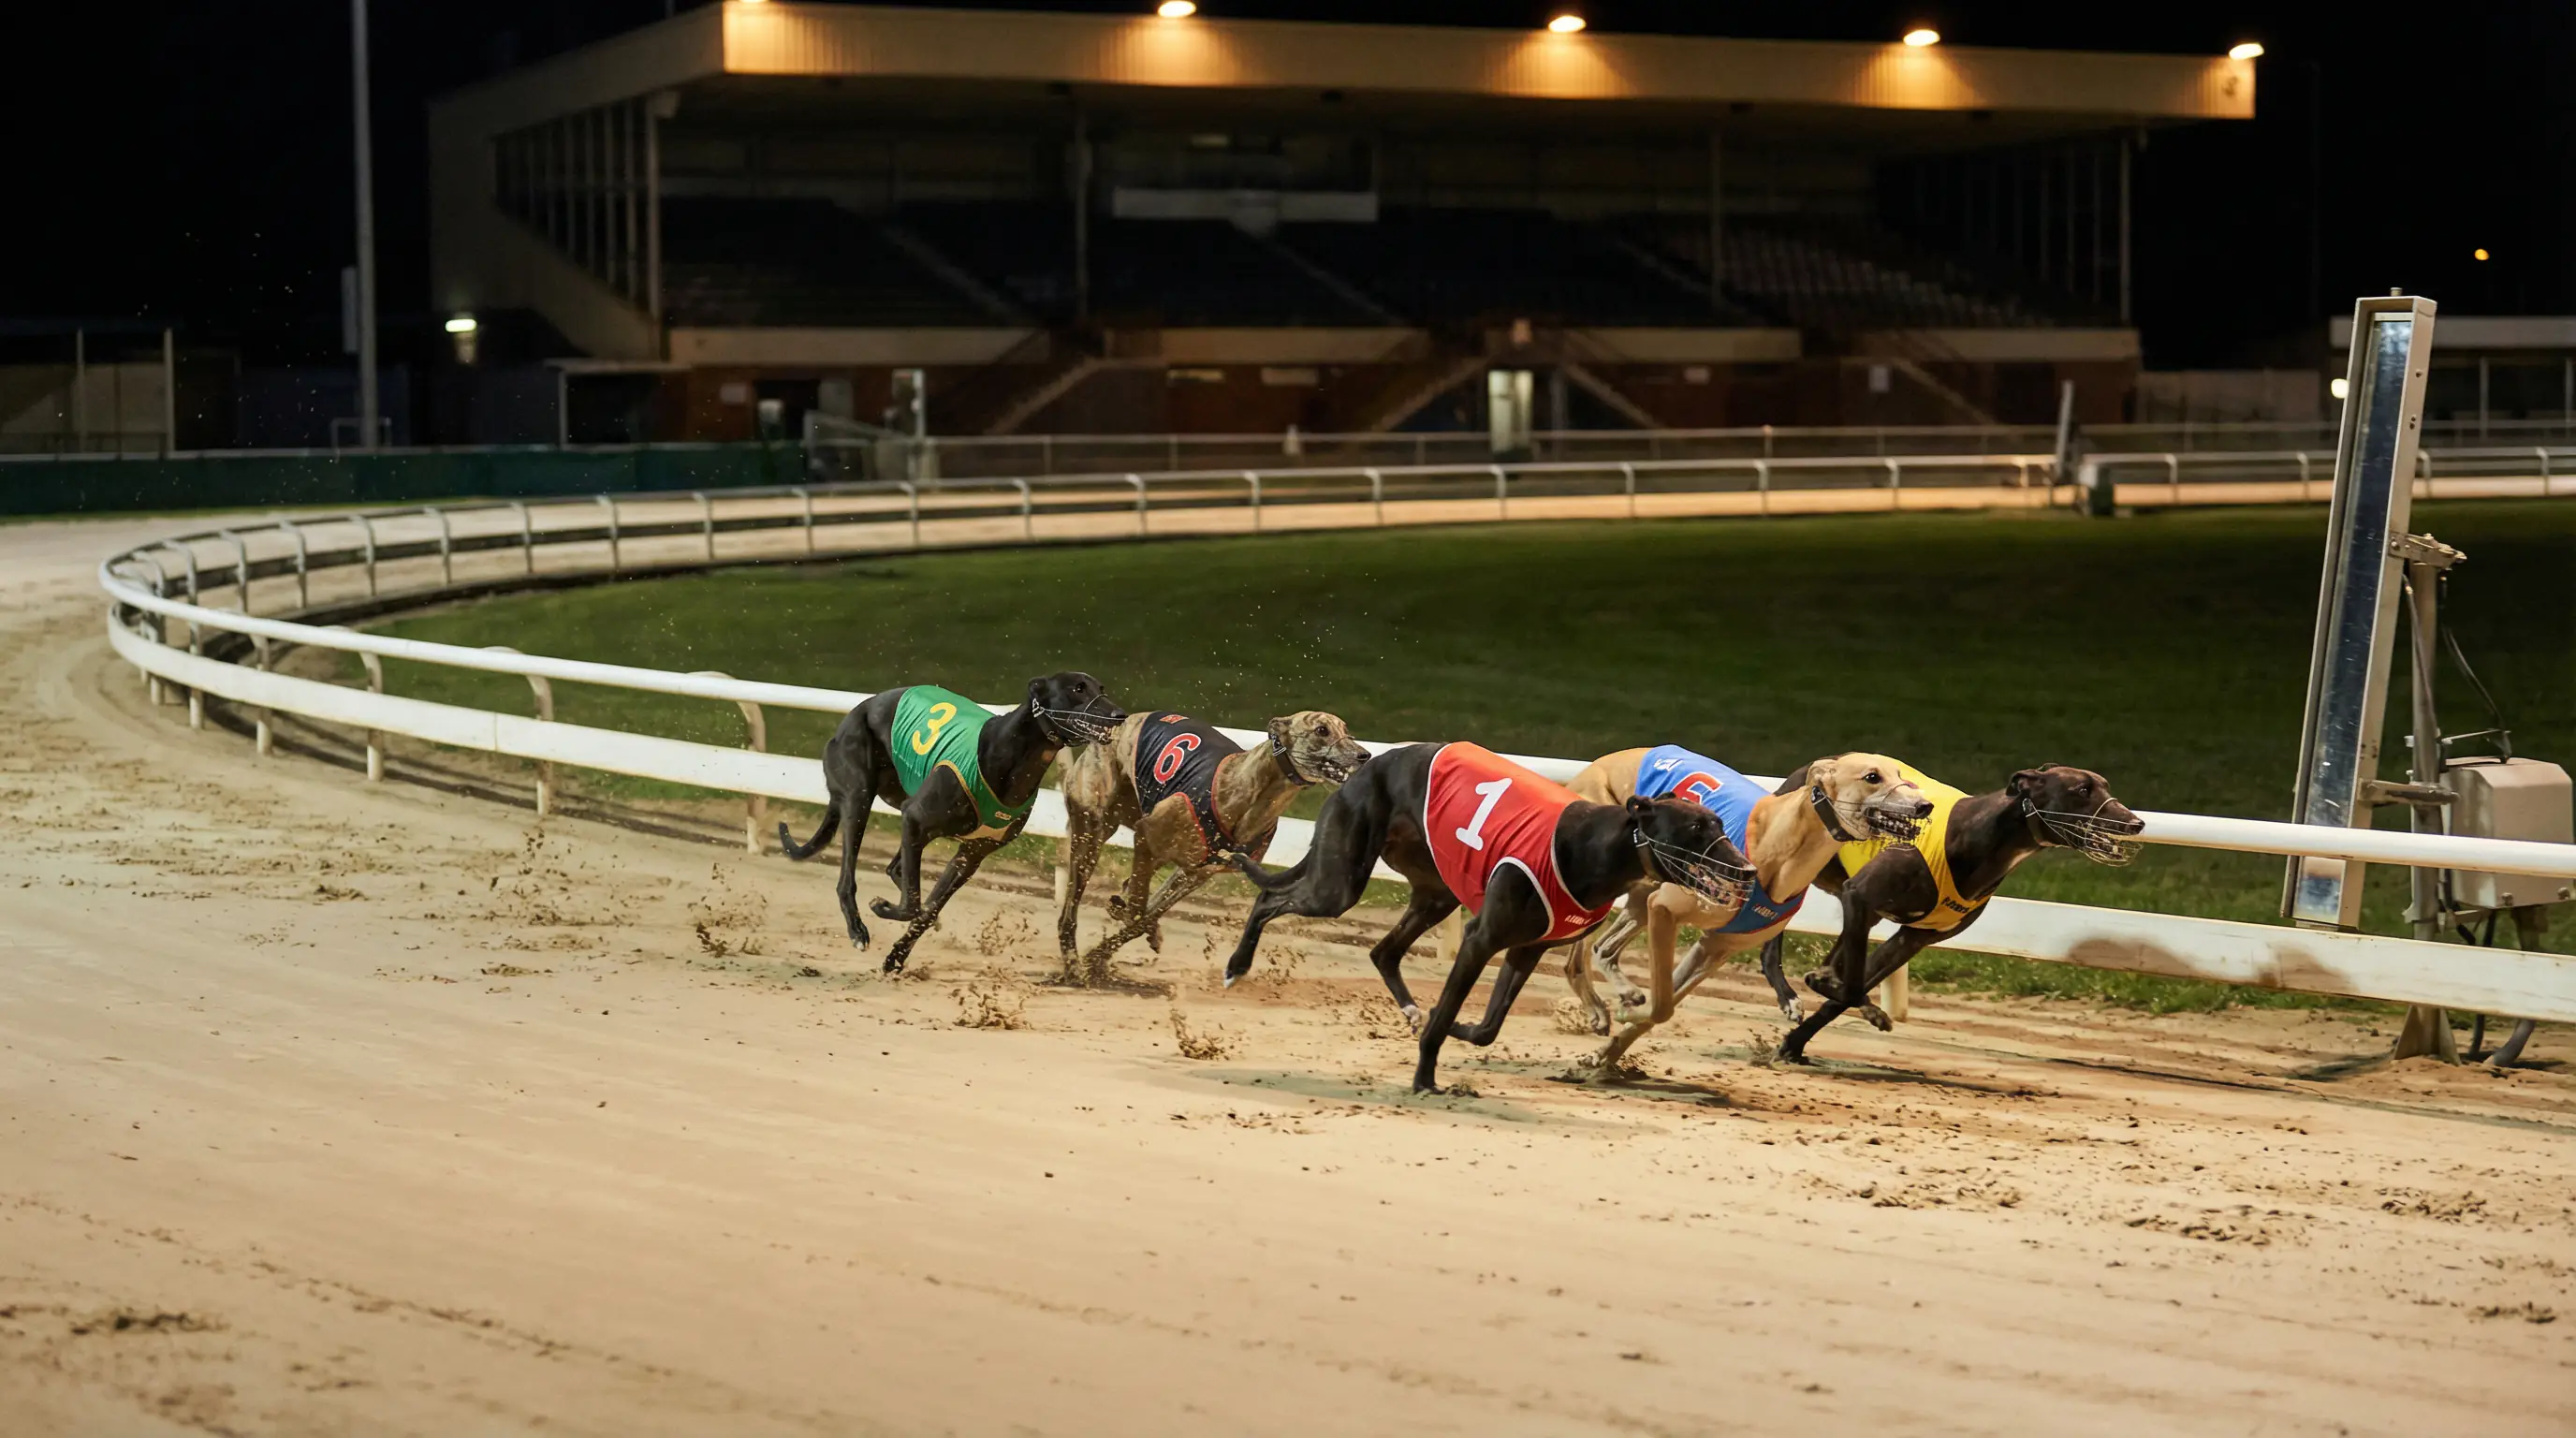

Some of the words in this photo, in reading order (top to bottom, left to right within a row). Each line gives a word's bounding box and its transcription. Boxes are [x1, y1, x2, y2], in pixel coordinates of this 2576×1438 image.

[912, 702, 957, 756] 3
[1153, 733, 1202, 785] 6
[1456, 778, 1513, 851] 1
